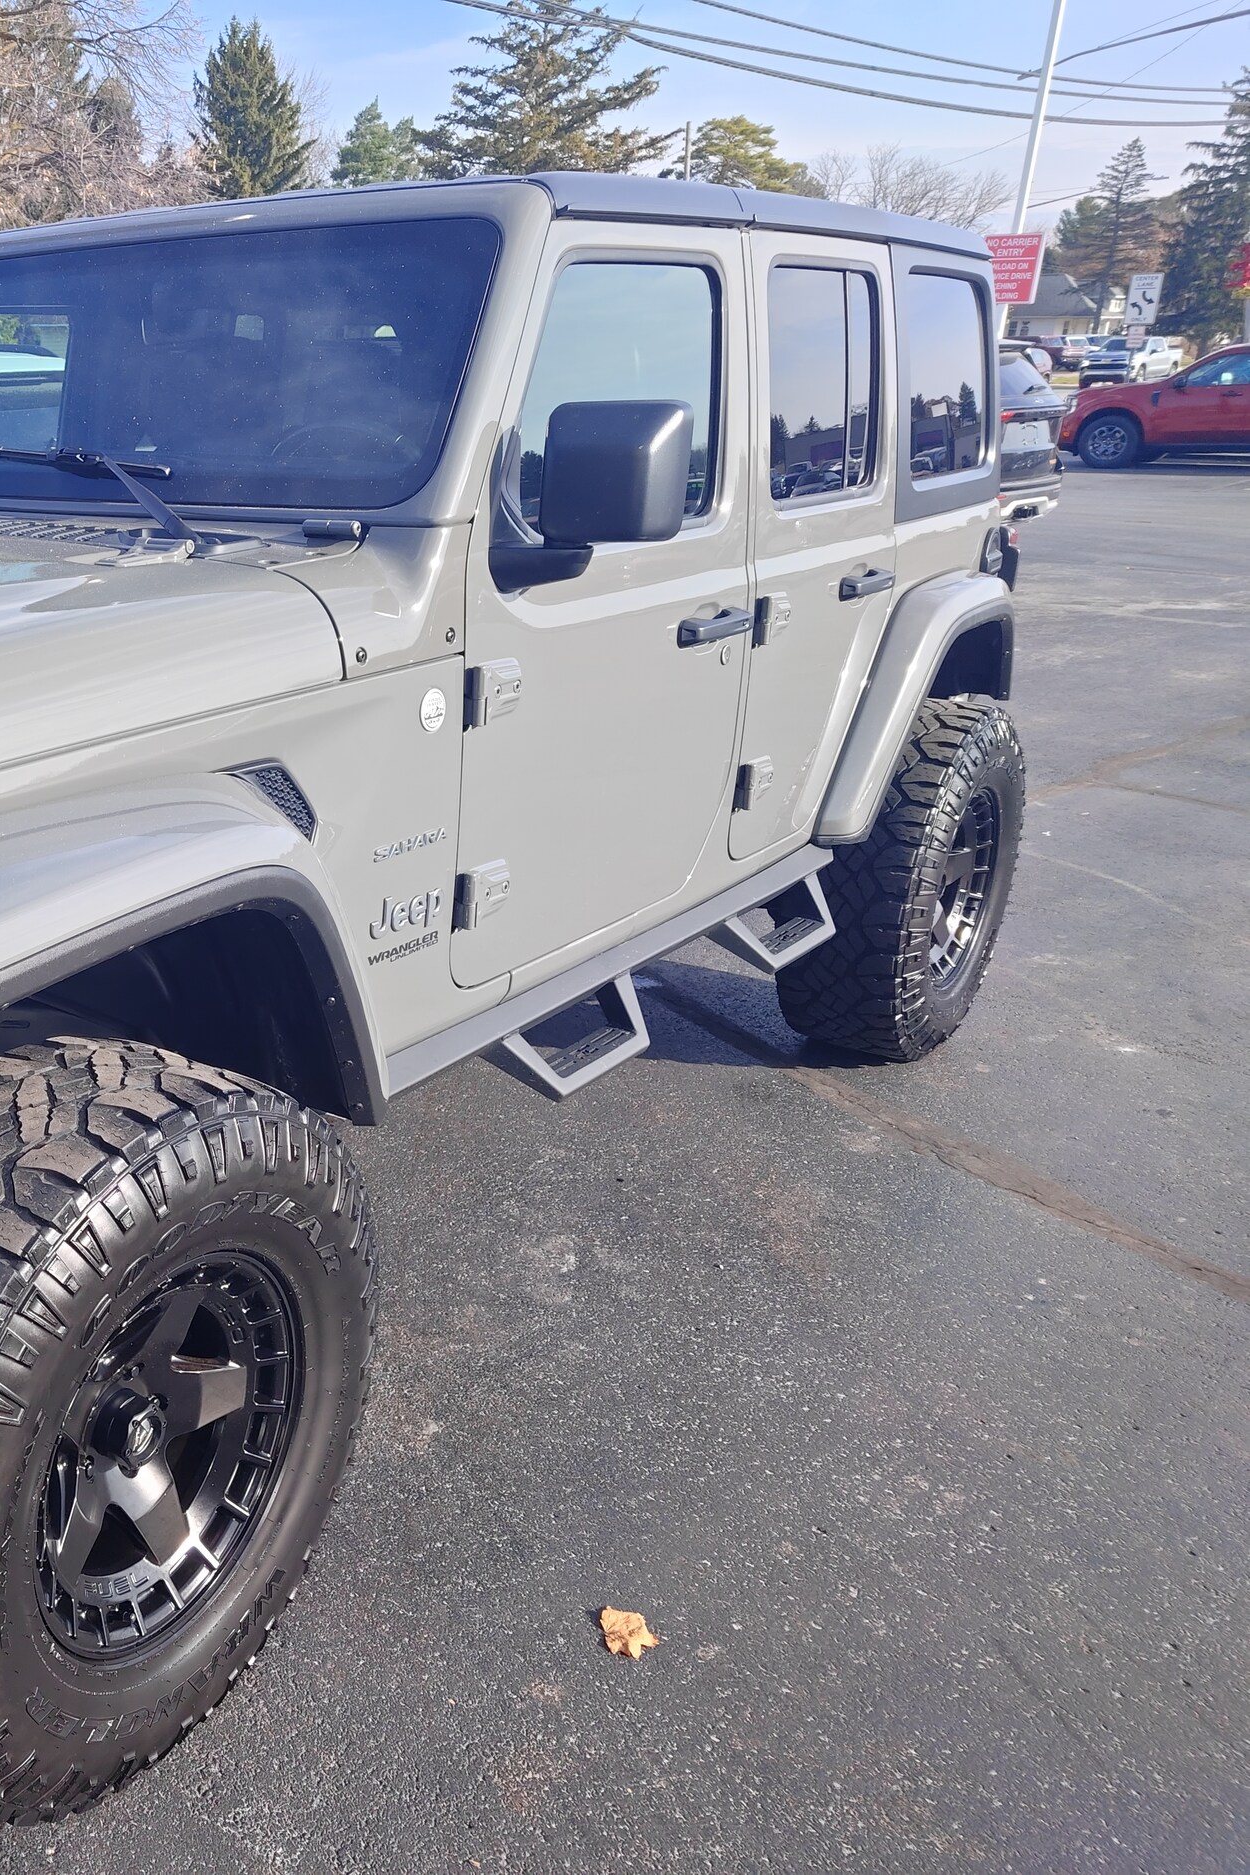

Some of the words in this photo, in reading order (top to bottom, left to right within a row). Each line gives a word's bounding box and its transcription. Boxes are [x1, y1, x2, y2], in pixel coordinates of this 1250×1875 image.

[996, 247, 1025, 256] ENTRY
[1001, 237, 1039, 246] CARRIER
[993, 262, 1016, 270] NLOAD
[1017, 262, 1029, 270] ON
[994, 272, 1010, 280] VICE
[1010, 272, 1033, 280] DRIVE
[373, 827, 447, 863] SAHARA
[369, 887, 445, 940] Jeep
[367, 930, 439, 966] WRANGLER
[390, 938, 439, 963] UNLIMITED
[80, 1190, 342, 1349] GOODYEAR
[84, 1573, 149, 1598] FUEL
[25, 1565, 287, 1744] WRANGLER
